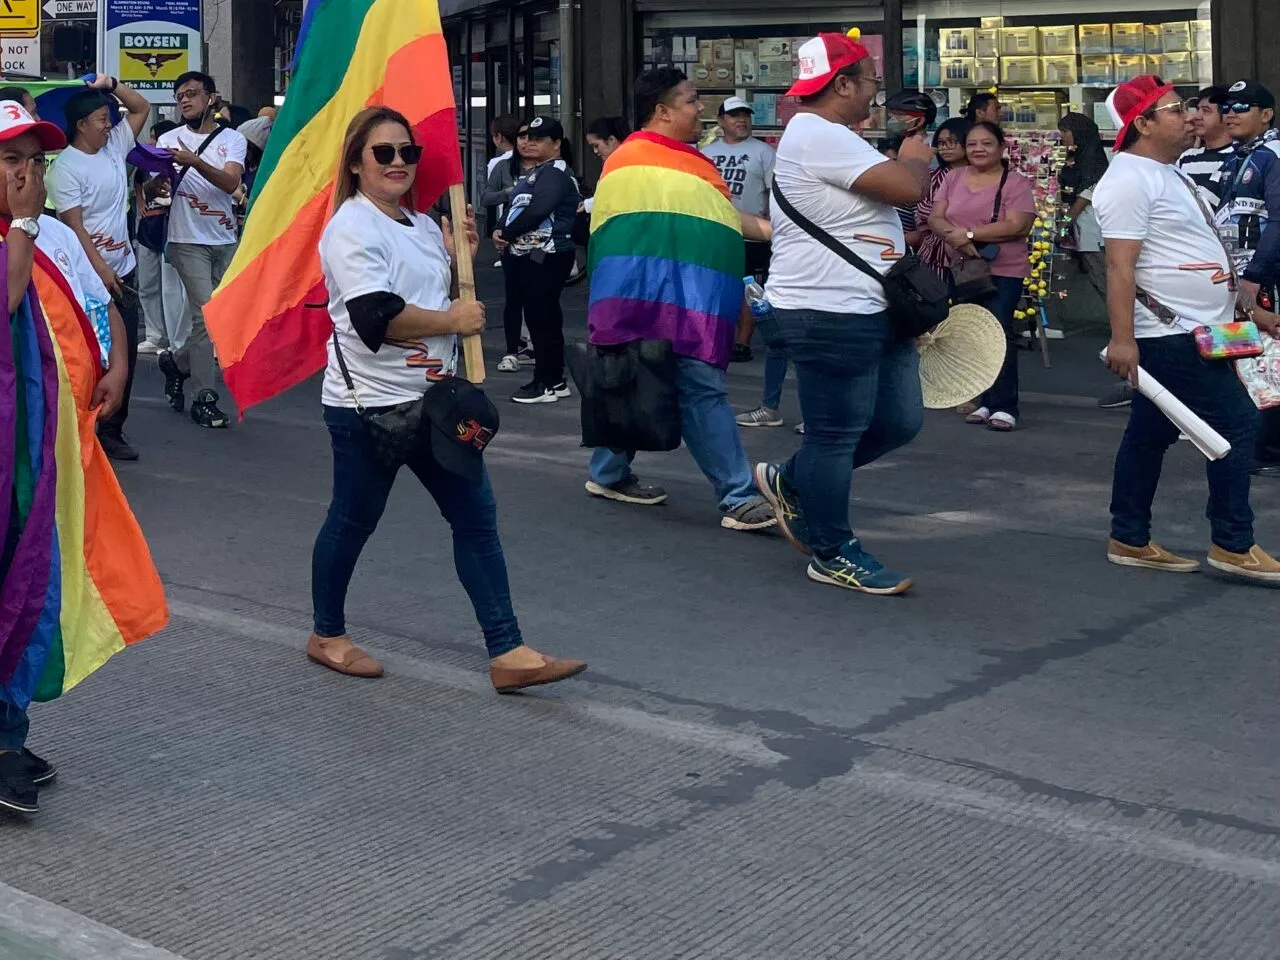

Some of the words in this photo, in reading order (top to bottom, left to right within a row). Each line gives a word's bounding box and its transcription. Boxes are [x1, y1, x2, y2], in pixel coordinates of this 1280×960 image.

[57, 2, 73, 12] ONE
[76, 1, 95, 12] WAY
[124, 35, 180, 48] BOYSEN
[8, 45, 29, 55] NOT
[1, 60, 25, 70] OCK
[717, 167, 747, 182] UD
